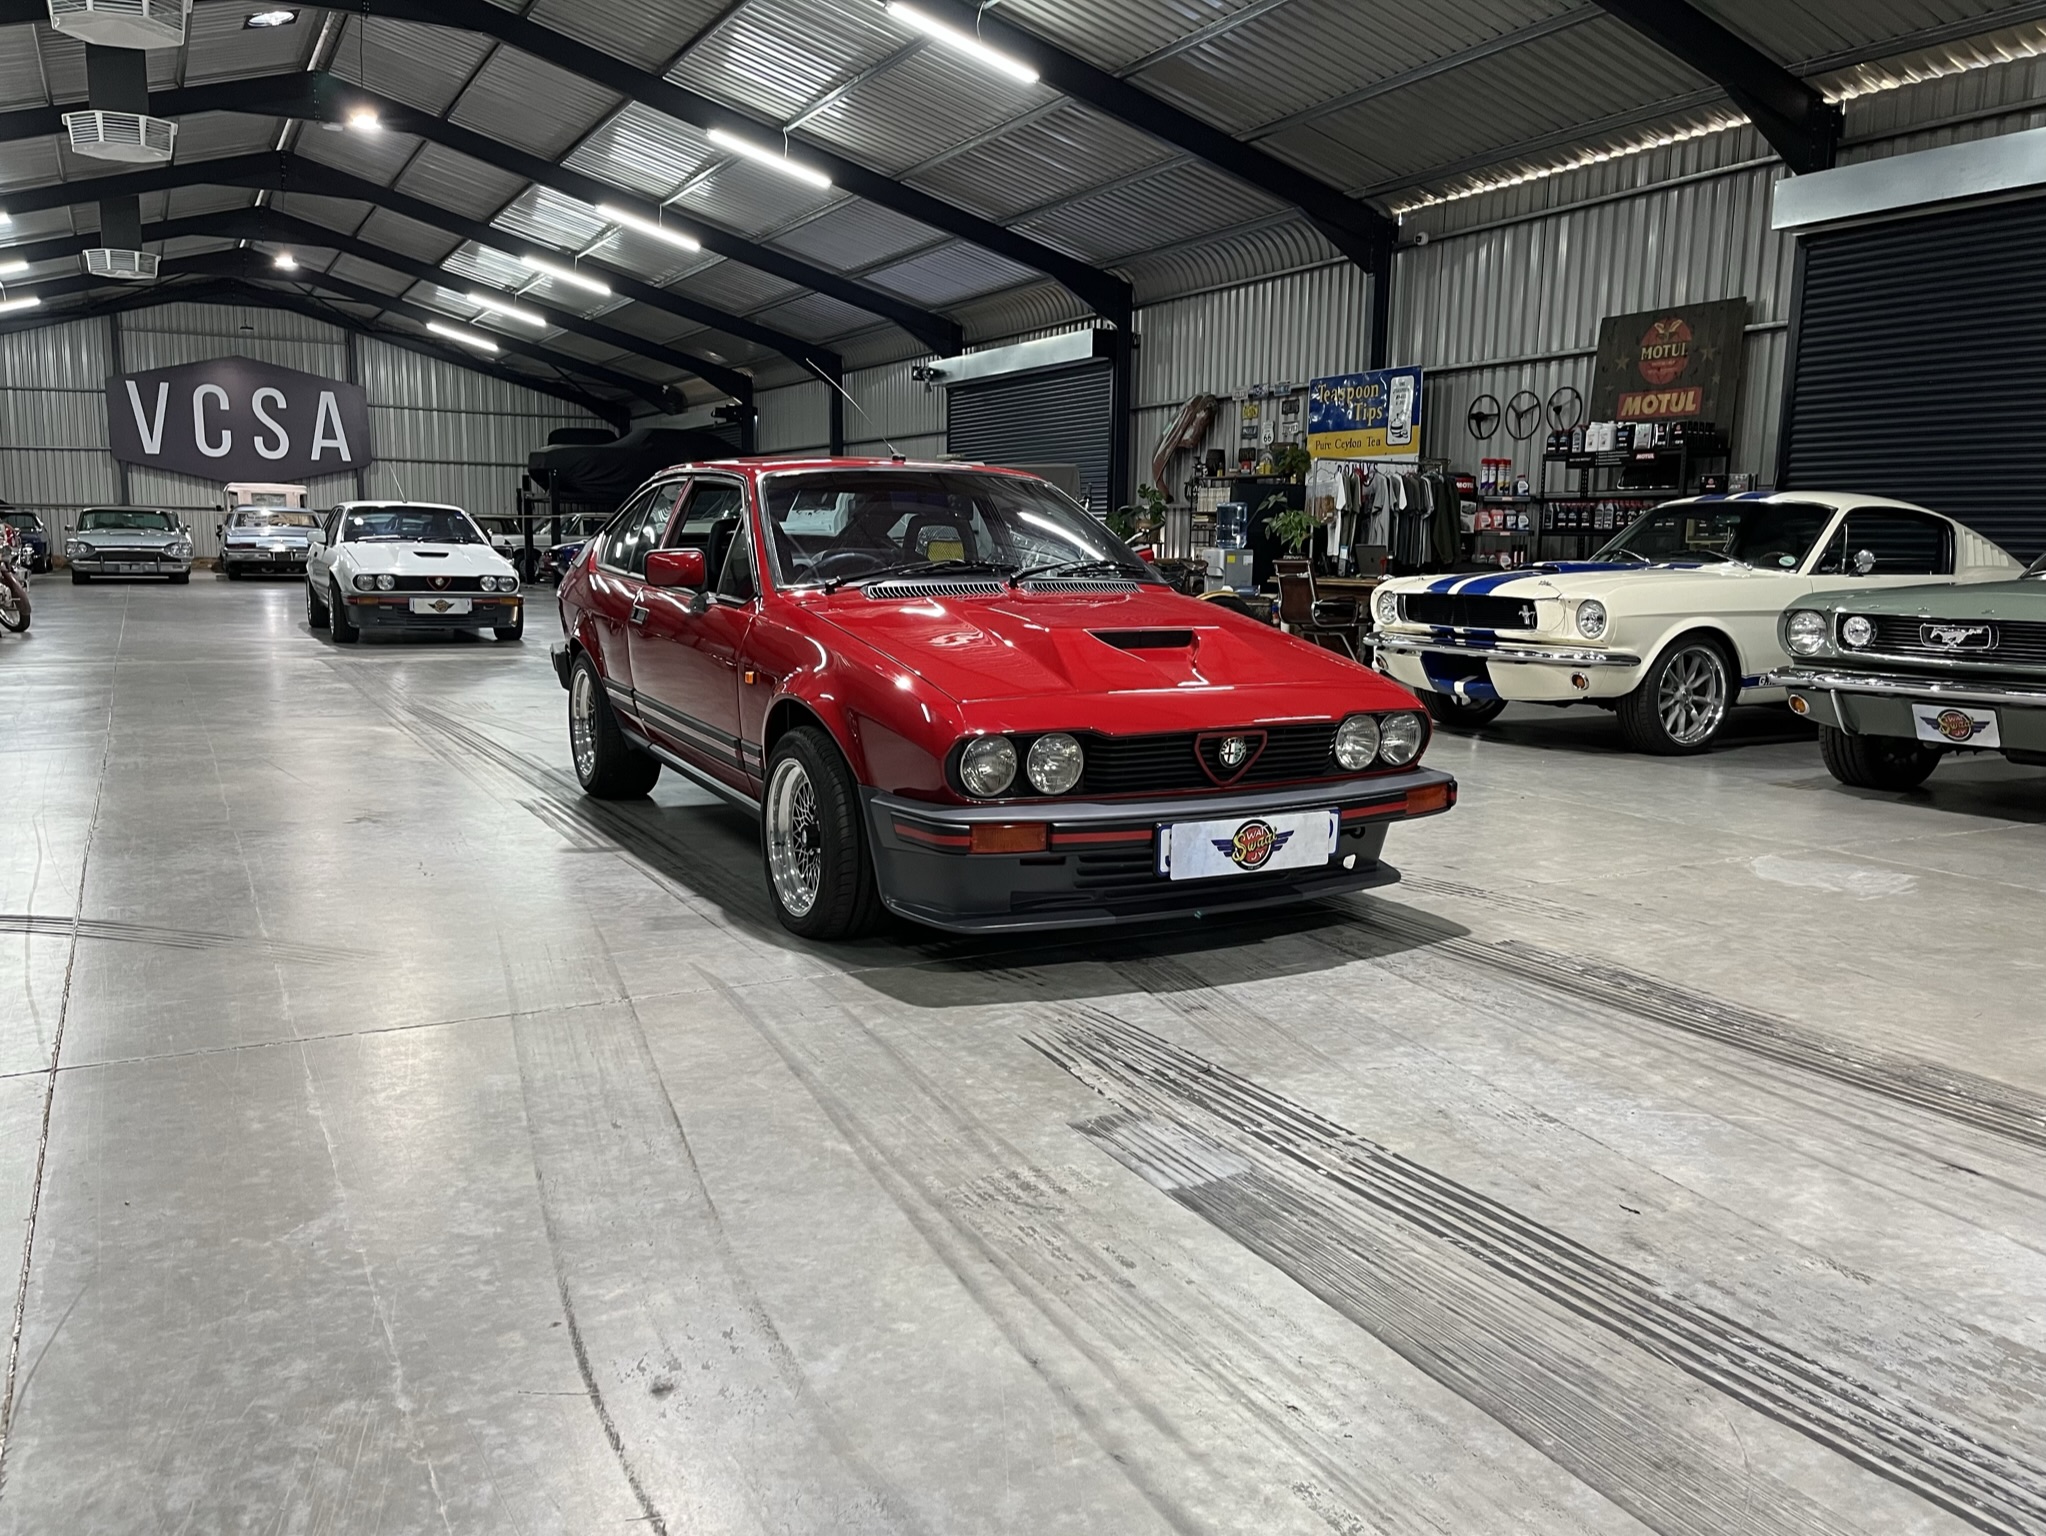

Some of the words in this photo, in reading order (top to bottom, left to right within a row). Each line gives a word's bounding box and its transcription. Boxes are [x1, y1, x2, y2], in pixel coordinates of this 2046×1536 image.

[1641, 342, 1688, 361] MOTUL
[1318, 383, 1380, 405] Teaspoon
[1620, 390, 1698, 417] MOTUL
[125, 379, 352, 462] VCSA
[1354, 402, 1383, 426] Tips
[1263, 433, 1272, 442] 66
[1315, 440, 1331, 450] Pure
[1335, 438, 1362, 451] Ceylon
[1367, 436, 1381, 447] Tea
[1251, 850, 1265, 860] JY
